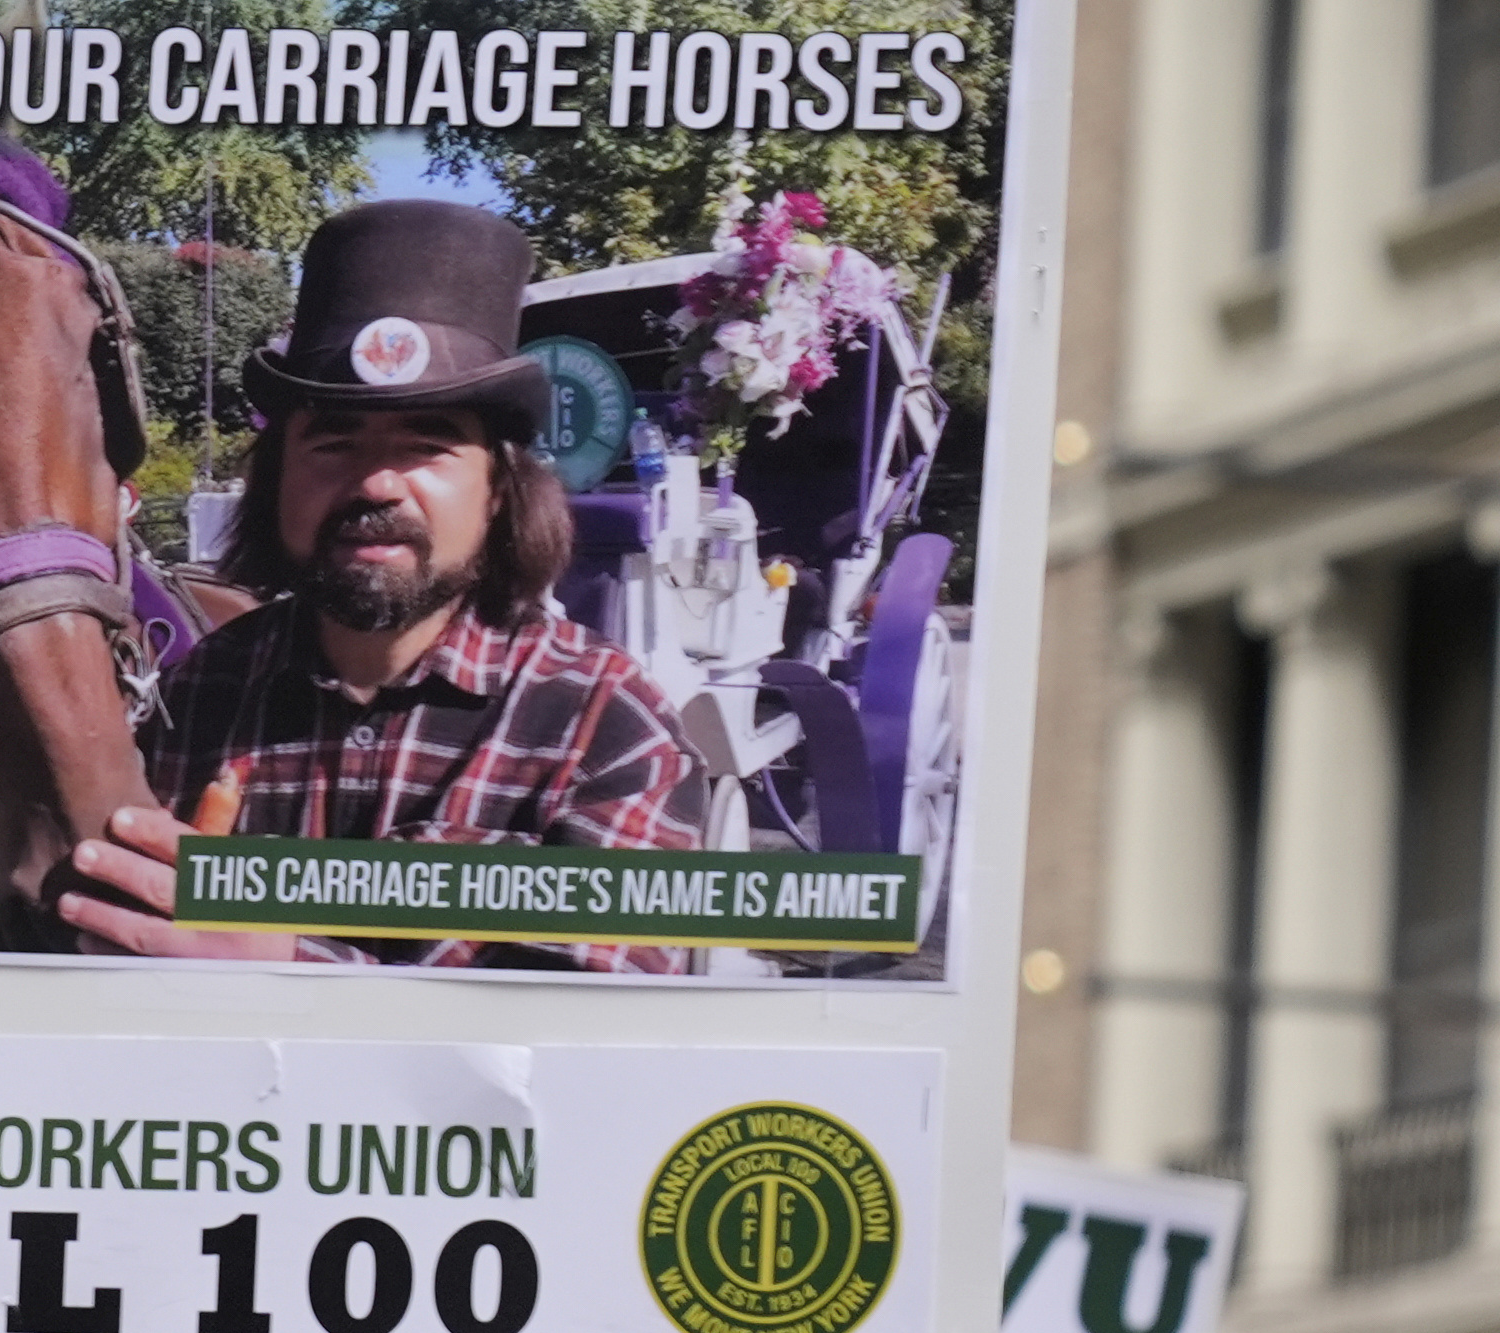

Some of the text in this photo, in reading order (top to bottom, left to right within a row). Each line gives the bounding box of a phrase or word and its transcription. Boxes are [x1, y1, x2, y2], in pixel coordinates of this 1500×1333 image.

[145, 26, 590, 131] CARRIAGE
[607, 28, 970, 134] HORSES
[189, 855, 907, 922] THIS CARRIAGE HORSE'S NAME IS AHMET
[303, 1121, 539, 1200] UNION
